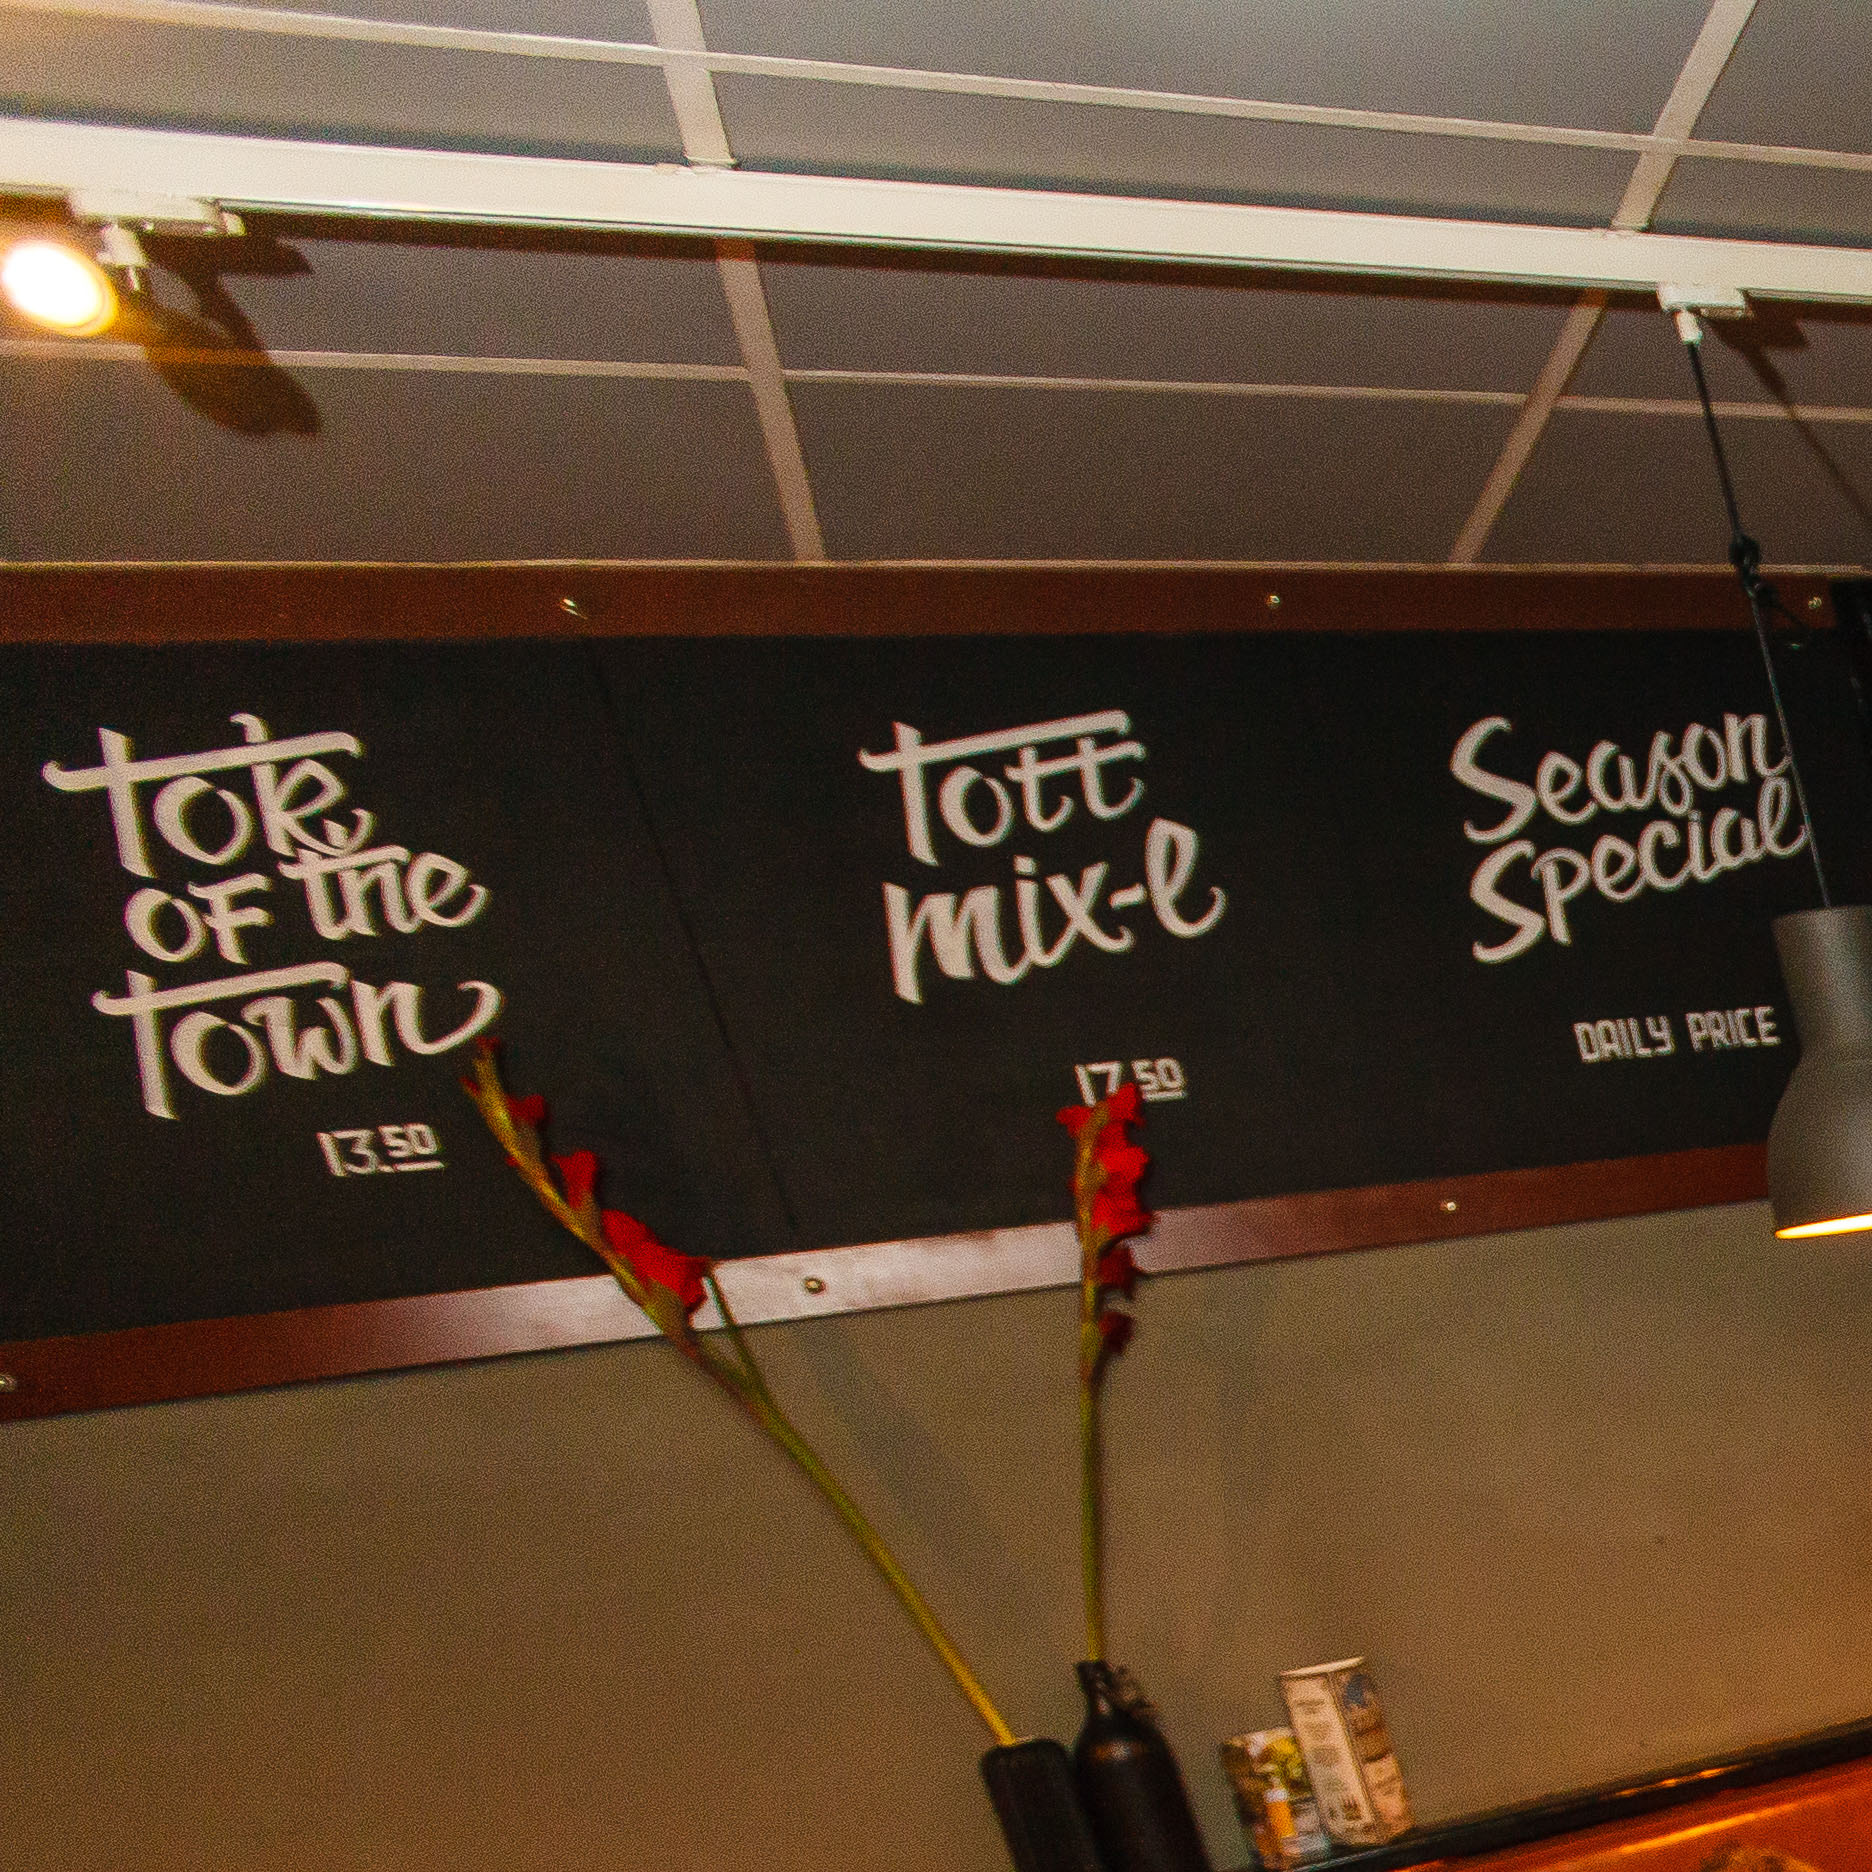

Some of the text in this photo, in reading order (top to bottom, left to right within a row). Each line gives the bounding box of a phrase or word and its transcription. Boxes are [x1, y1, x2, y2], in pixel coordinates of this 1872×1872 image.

[1450, 711, 1792, 845] Season
[1470, 775, 1810, 964] Special
[1573, 1006, 1782, 1064] DAILY PRICE
[316, 1122, 445, 1178] 13.50
